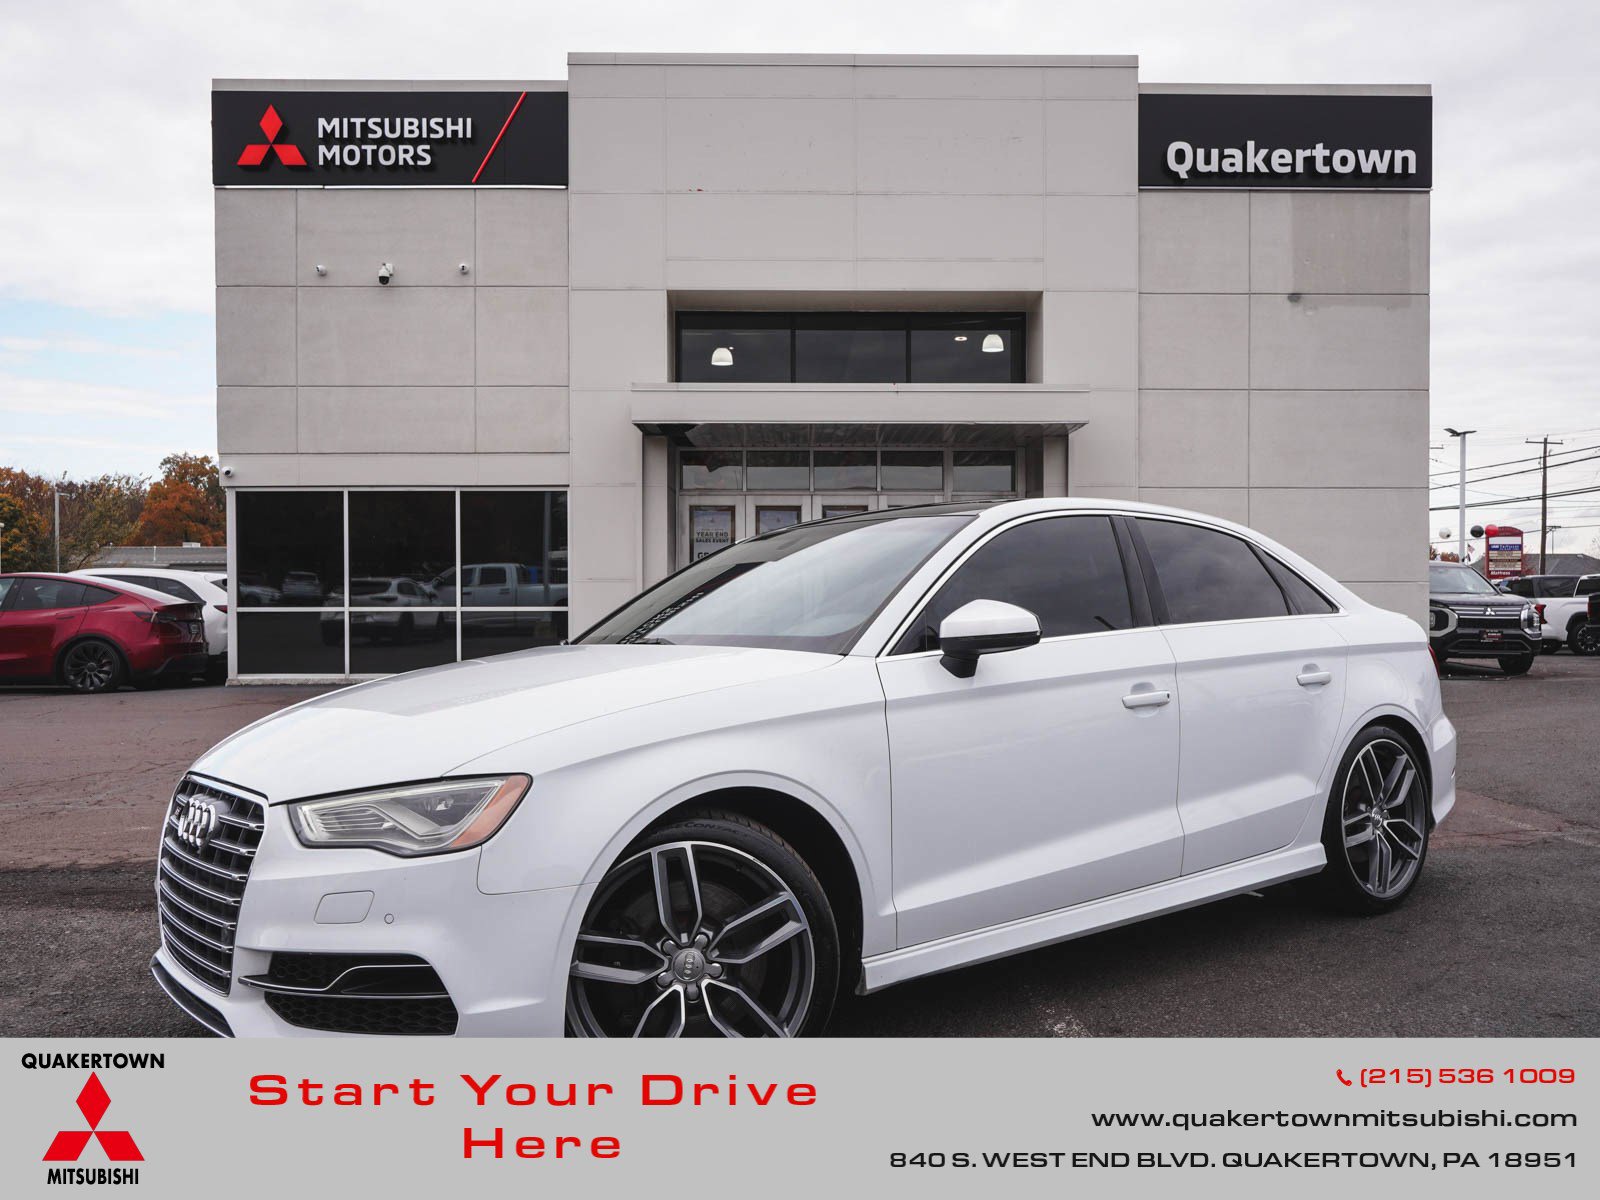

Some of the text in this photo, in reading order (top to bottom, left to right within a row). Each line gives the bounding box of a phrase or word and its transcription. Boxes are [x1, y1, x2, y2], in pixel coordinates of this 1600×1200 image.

[318, 117, 472, 139] MITSUBISHI
[318, 144, 432, 166] MOTORS
[1166, 140, 1417, 179] Quakertown
